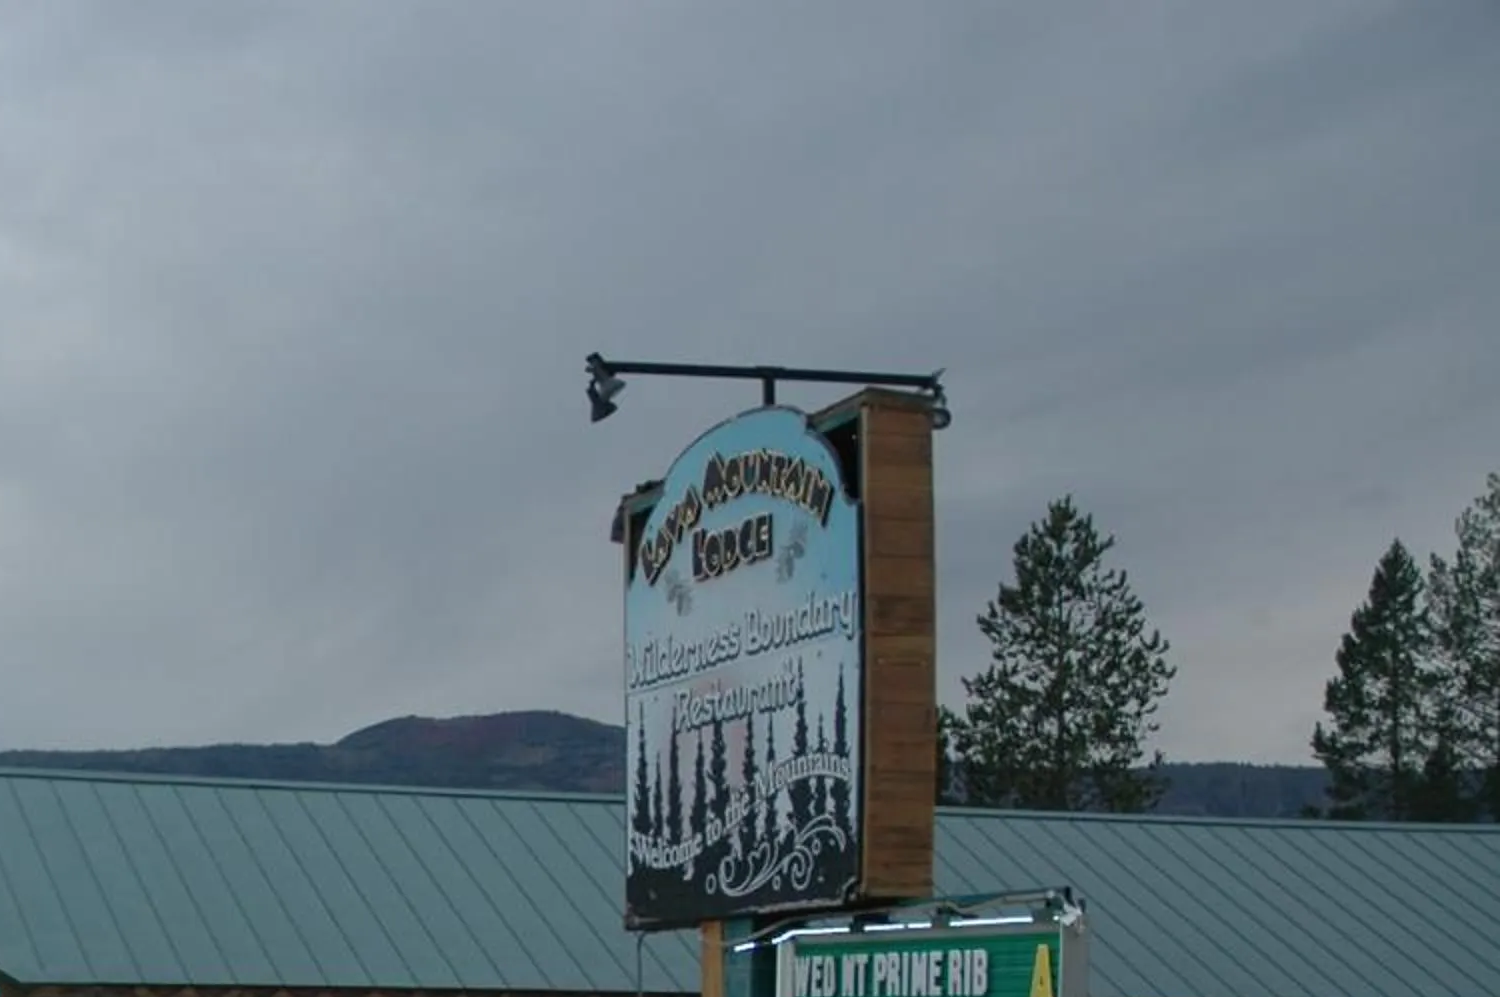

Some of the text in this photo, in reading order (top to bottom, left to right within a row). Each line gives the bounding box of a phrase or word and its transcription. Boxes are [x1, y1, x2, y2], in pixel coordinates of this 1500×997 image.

[627, 590, 857, 688] Wilderness Boundary
[674, 656, 800, 734] Restaurant
[631, 751, 850, 869] Welcome to the Mountains
[794, 949, 989, 997] WED NT PRIME RIB
